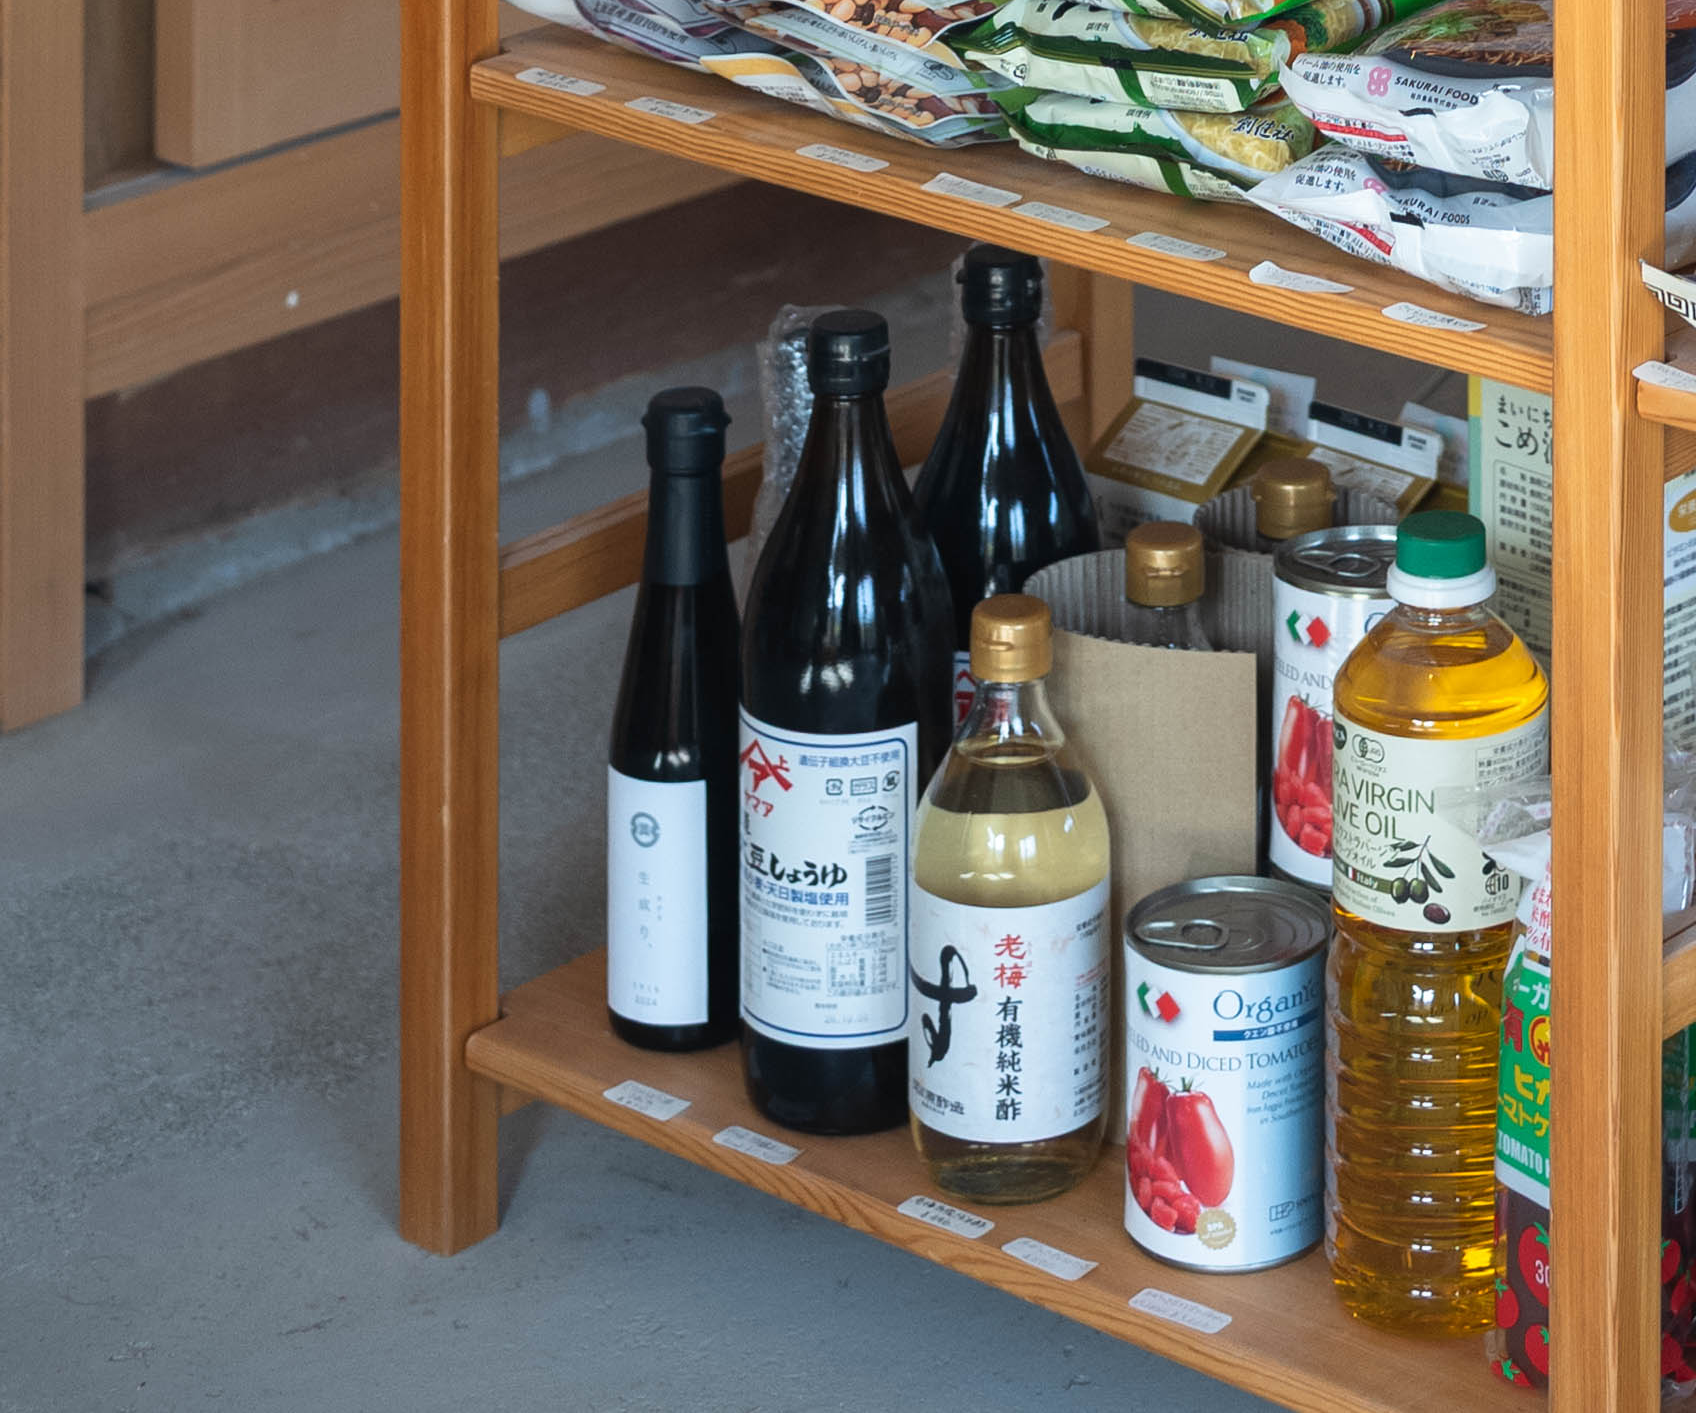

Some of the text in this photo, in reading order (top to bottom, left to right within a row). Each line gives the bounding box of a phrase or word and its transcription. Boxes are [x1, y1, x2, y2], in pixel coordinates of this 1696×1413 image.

[1303, 69, 1347, 89] 促進します。
[1394, 75, 1480, 106] SAKURAI FOOD
[1233, 114, 1295, 142] 創健社
[1295, 174, 1346, 193] 促進します。
[1441, 210, 1471, 225] FOODS
[798, 749, 901, 769] 遺伝子組換大豆不使用
[1351, 777, 1435, 815] VIRGIN
[1365, 811, 1406, 842] OIL
[1356, 871, 1379, 890] Italy
[993, 934, 1028, 989] 老梅
[910, 944, 978, 1069] す
[995, 995, 1024, 1122] 有機純米酢
[1151, 1047, 1242, 1072] AND DICED
[1497, 1128, 1546, 1172] TOMATO
